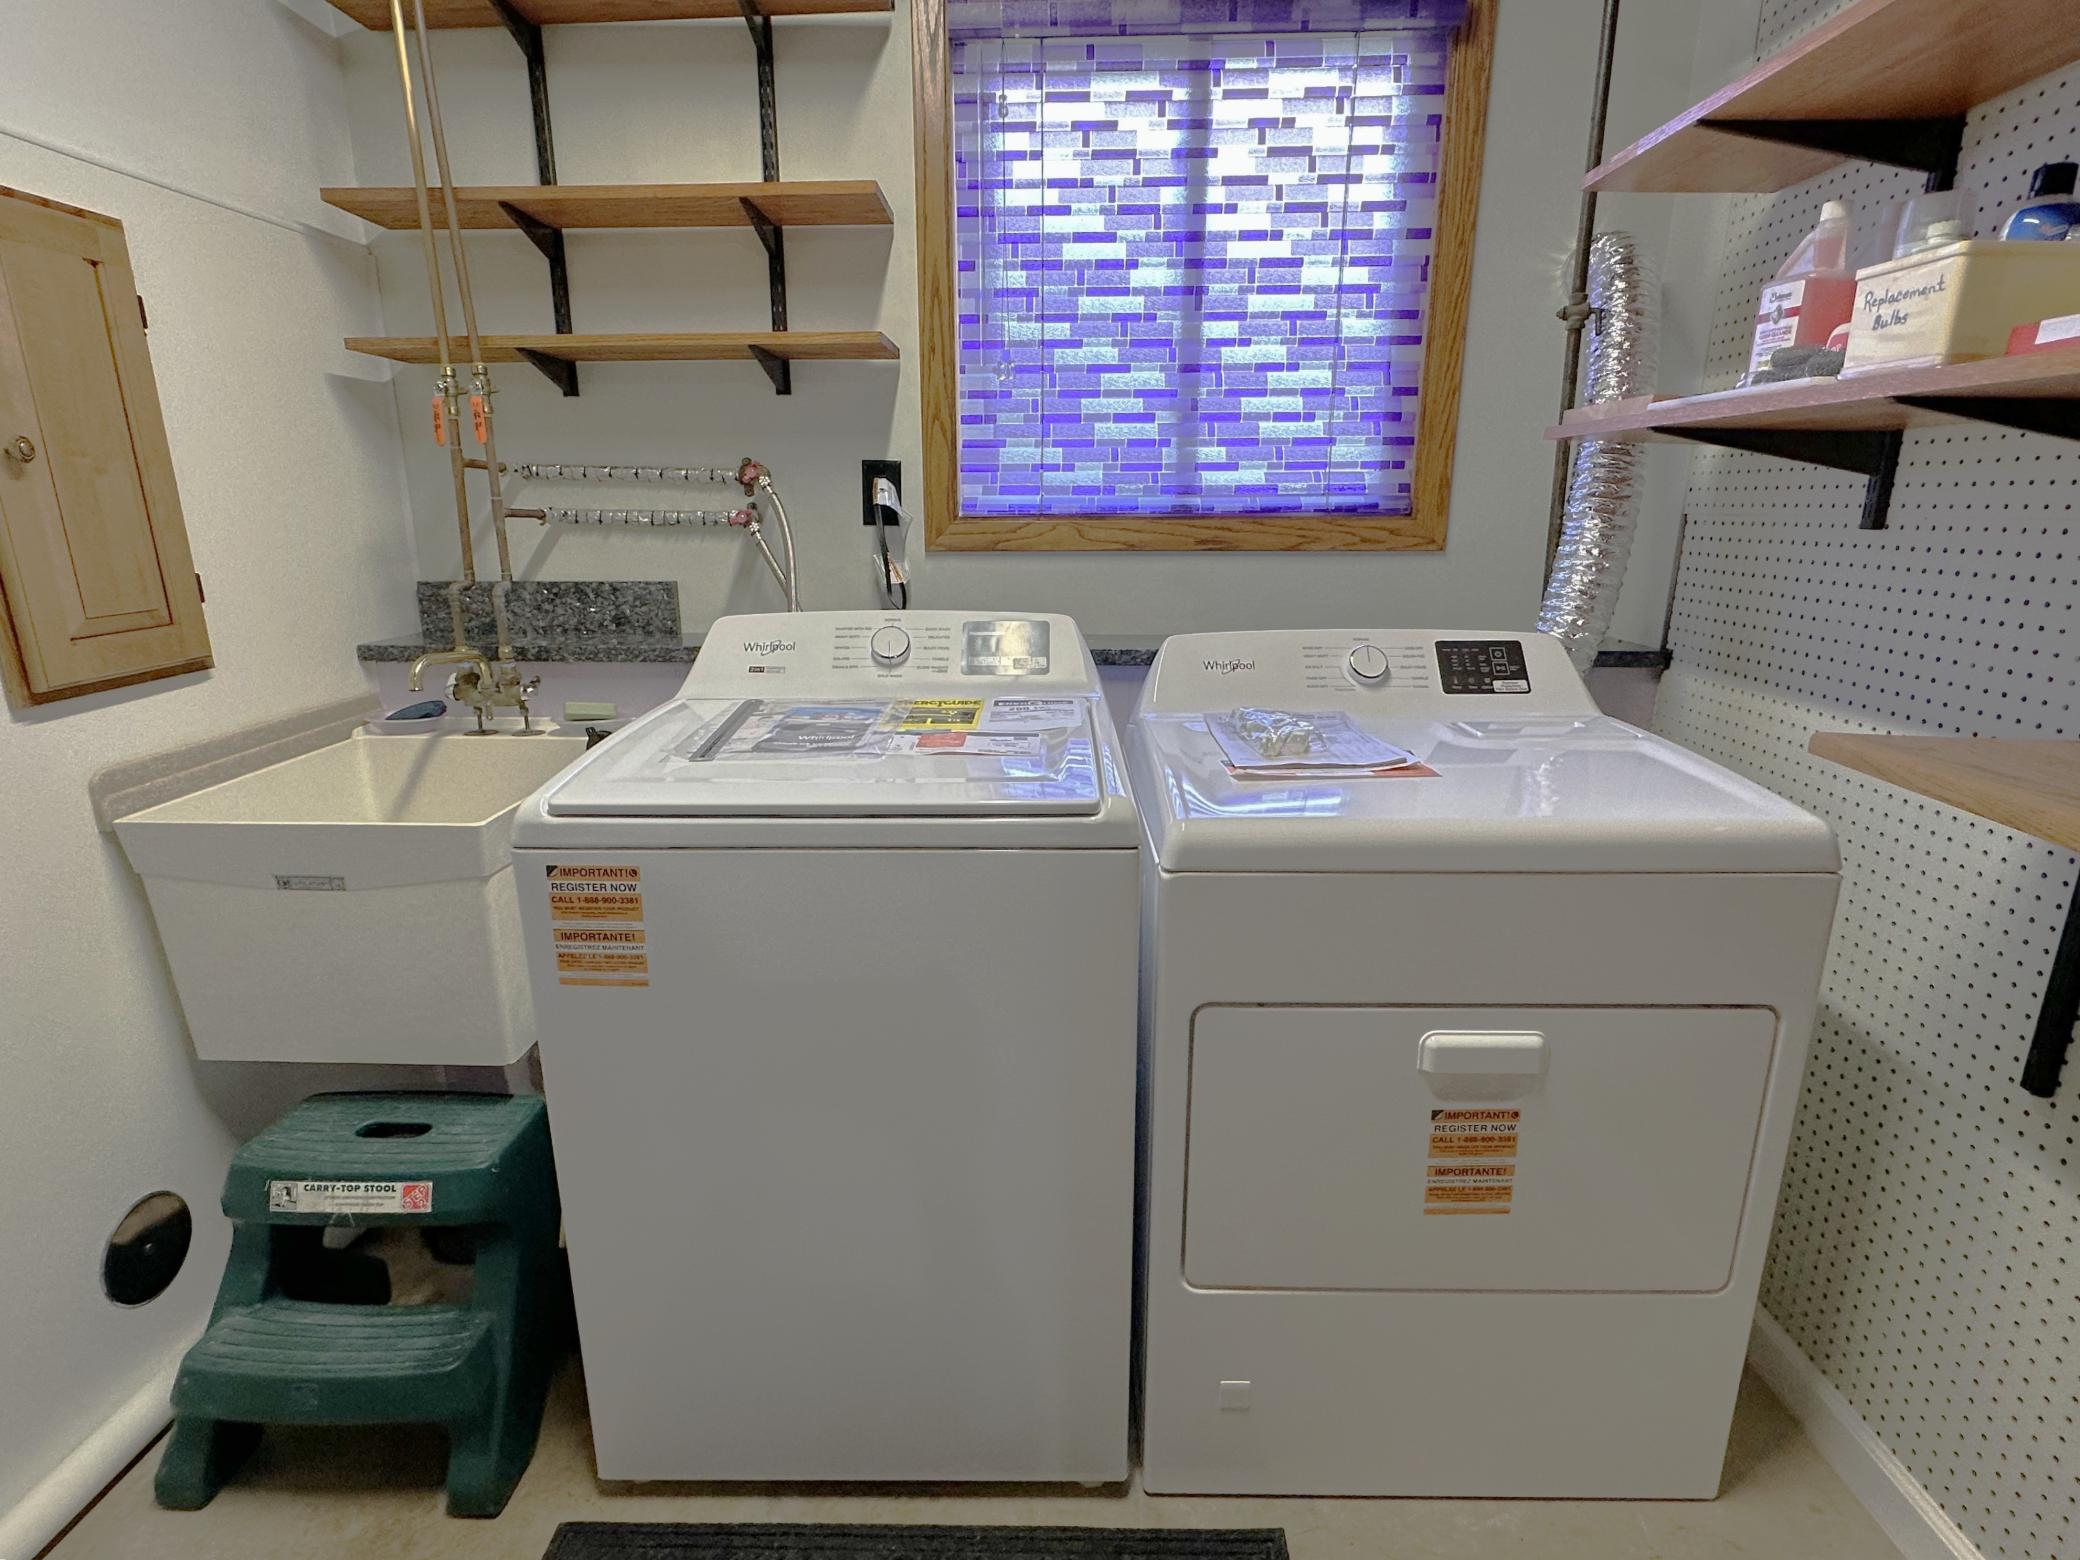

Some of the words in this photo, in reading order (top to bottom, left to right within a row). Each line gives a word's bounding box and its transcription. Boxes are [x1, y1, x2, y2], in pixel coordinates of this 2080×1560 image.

[1864, 273, 1946, 312] Replacement
[1872, 309, 1909, 331] Bulbs
[743, 640, 796, 655] Whirlpool
[1202, 659, 1256, 674] Whirlpool
[559, 867, 628, 878] IMPORTANT!
[551, 882, 607, 892] REGISTER
[610, 882, 637, 892] NOW
[551, 896, 575, 904] CALL
[560, 931, 636, 942] IMPORTANTE!
[1444, 1111, 1510, 1120] IMPORTANT!
[1434, 1124, 1487, 1133] REGISTER
[1490, 1123, 1517, 1132] NOW
[1432, 1136, 1455, 1144] CALL
[1434, 1167, 1506, 1177] IMPORTANTE!
[303, 1184, 362, 1193] CARRY-TOP
[364, 1184, 397, 1193] STOOL
[402, 1184, 427, 1209] STEP
